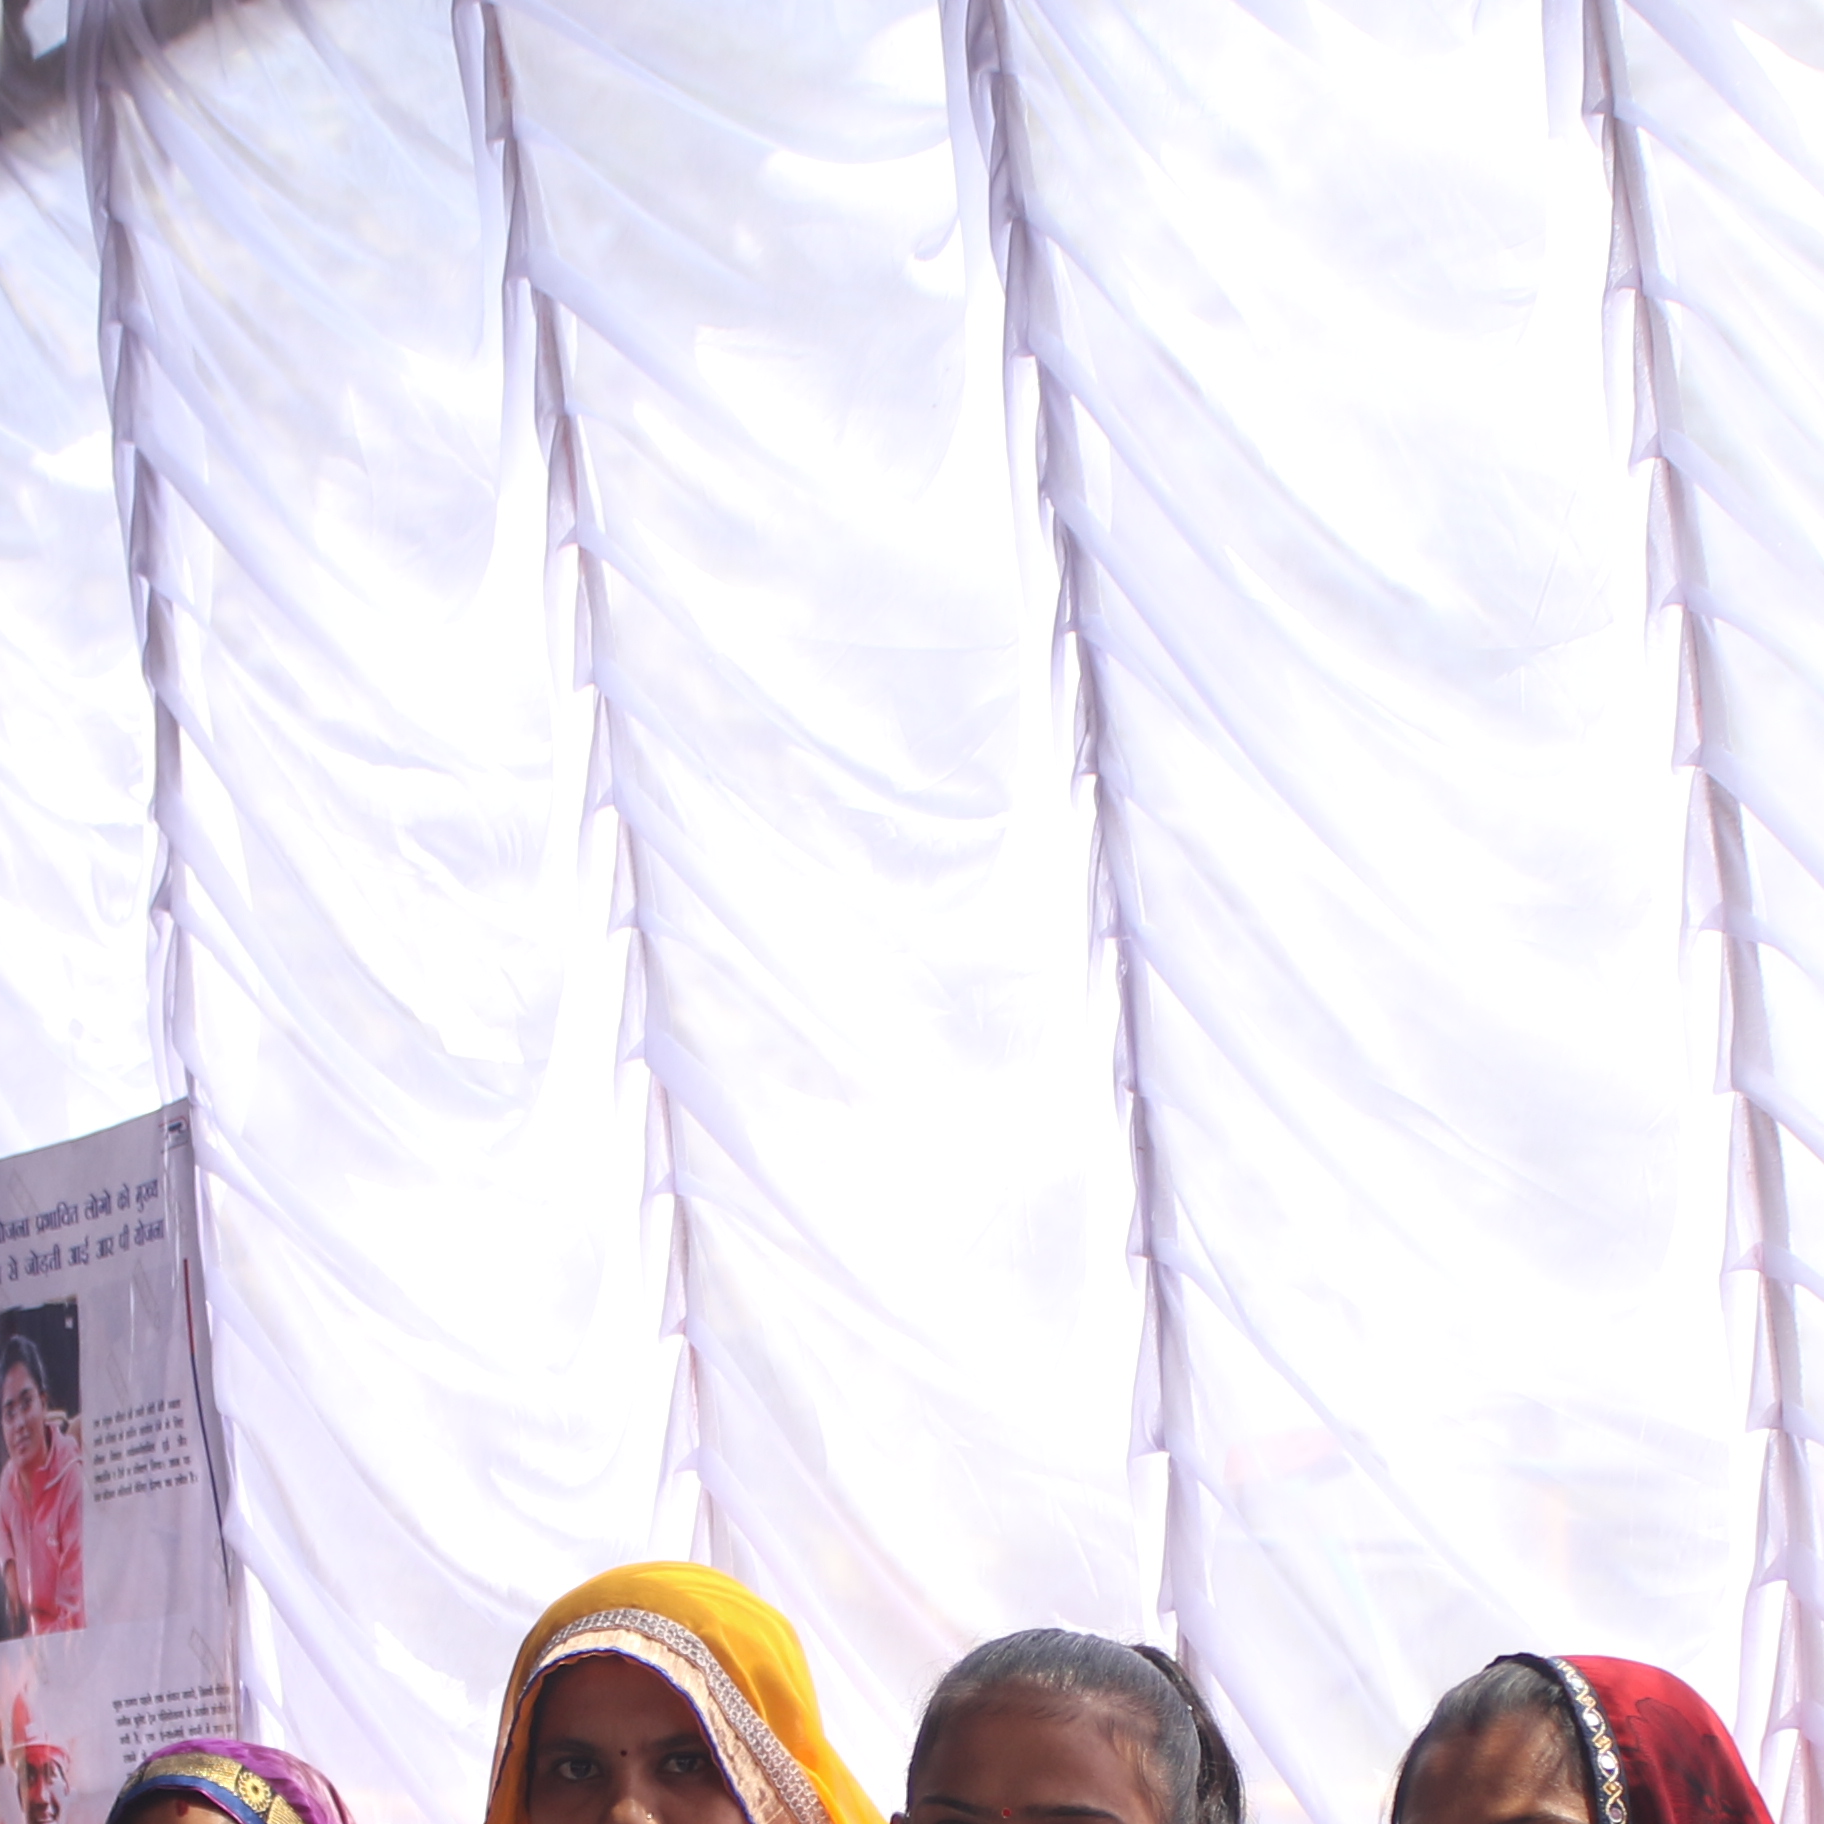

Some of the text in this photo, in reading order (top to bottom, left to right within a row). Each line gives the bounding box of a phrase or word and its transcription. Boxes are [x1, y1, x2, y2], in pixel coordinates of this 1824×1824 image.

[36, 1201, 79, 1234] प्रभावित
[117, 1182, 130, 1211] को
[135, 1178, 158, 1213] मुख्य
[8, 1254, 19, 1282] से
[68, 1234, 90, 1267] आई
[95, 1236, 114, 1260] आर
[118, 1223, 130, 1252] पी
[134, 1218, 164, 1246] योजना
